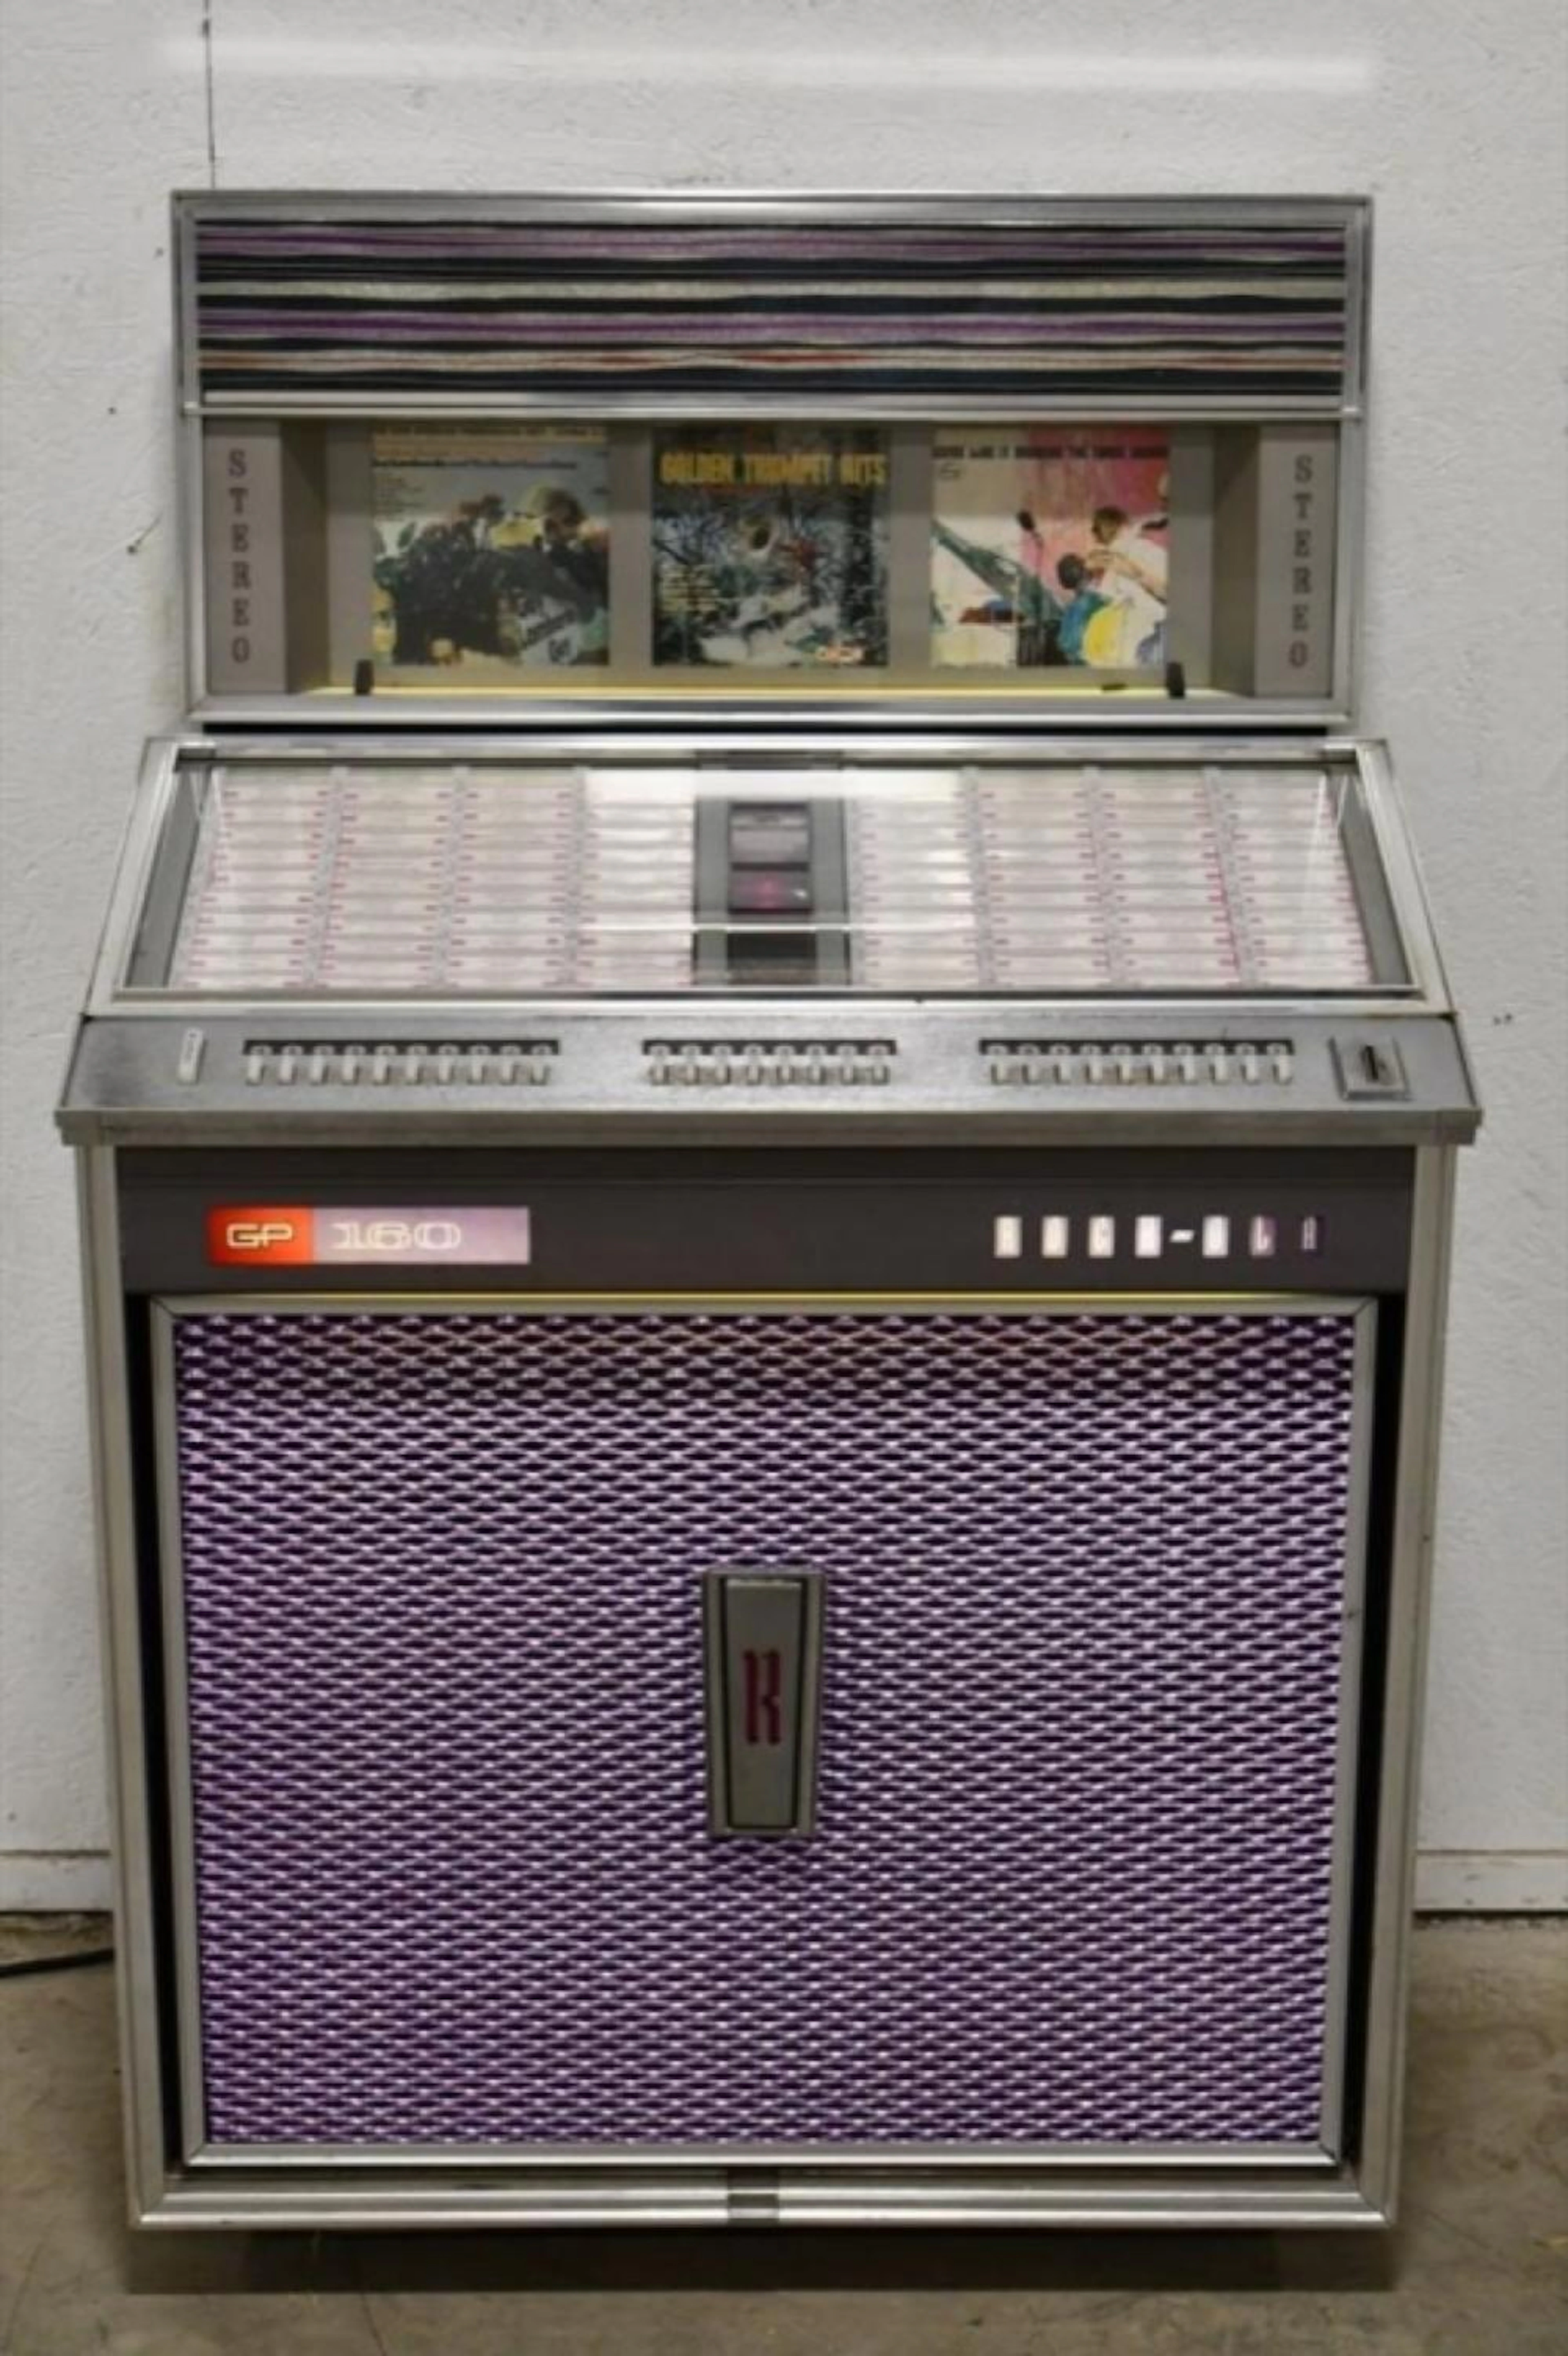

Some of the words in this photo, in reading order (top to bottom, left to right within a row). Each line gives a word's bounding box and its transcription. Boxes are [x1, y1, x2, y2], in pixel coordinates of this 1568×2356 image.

[660, 452, 734, 485] GOLDEN
[742, 453, 832, 486] TRUMPET
[840, 453, 887, 486] HITS
[228, 448, 251, 664] STEREO
[1289, 454, 1313, 669] STEREO
[226, 1223, 294, 1249] GP
[332, 1221, 462, 1250] 160
